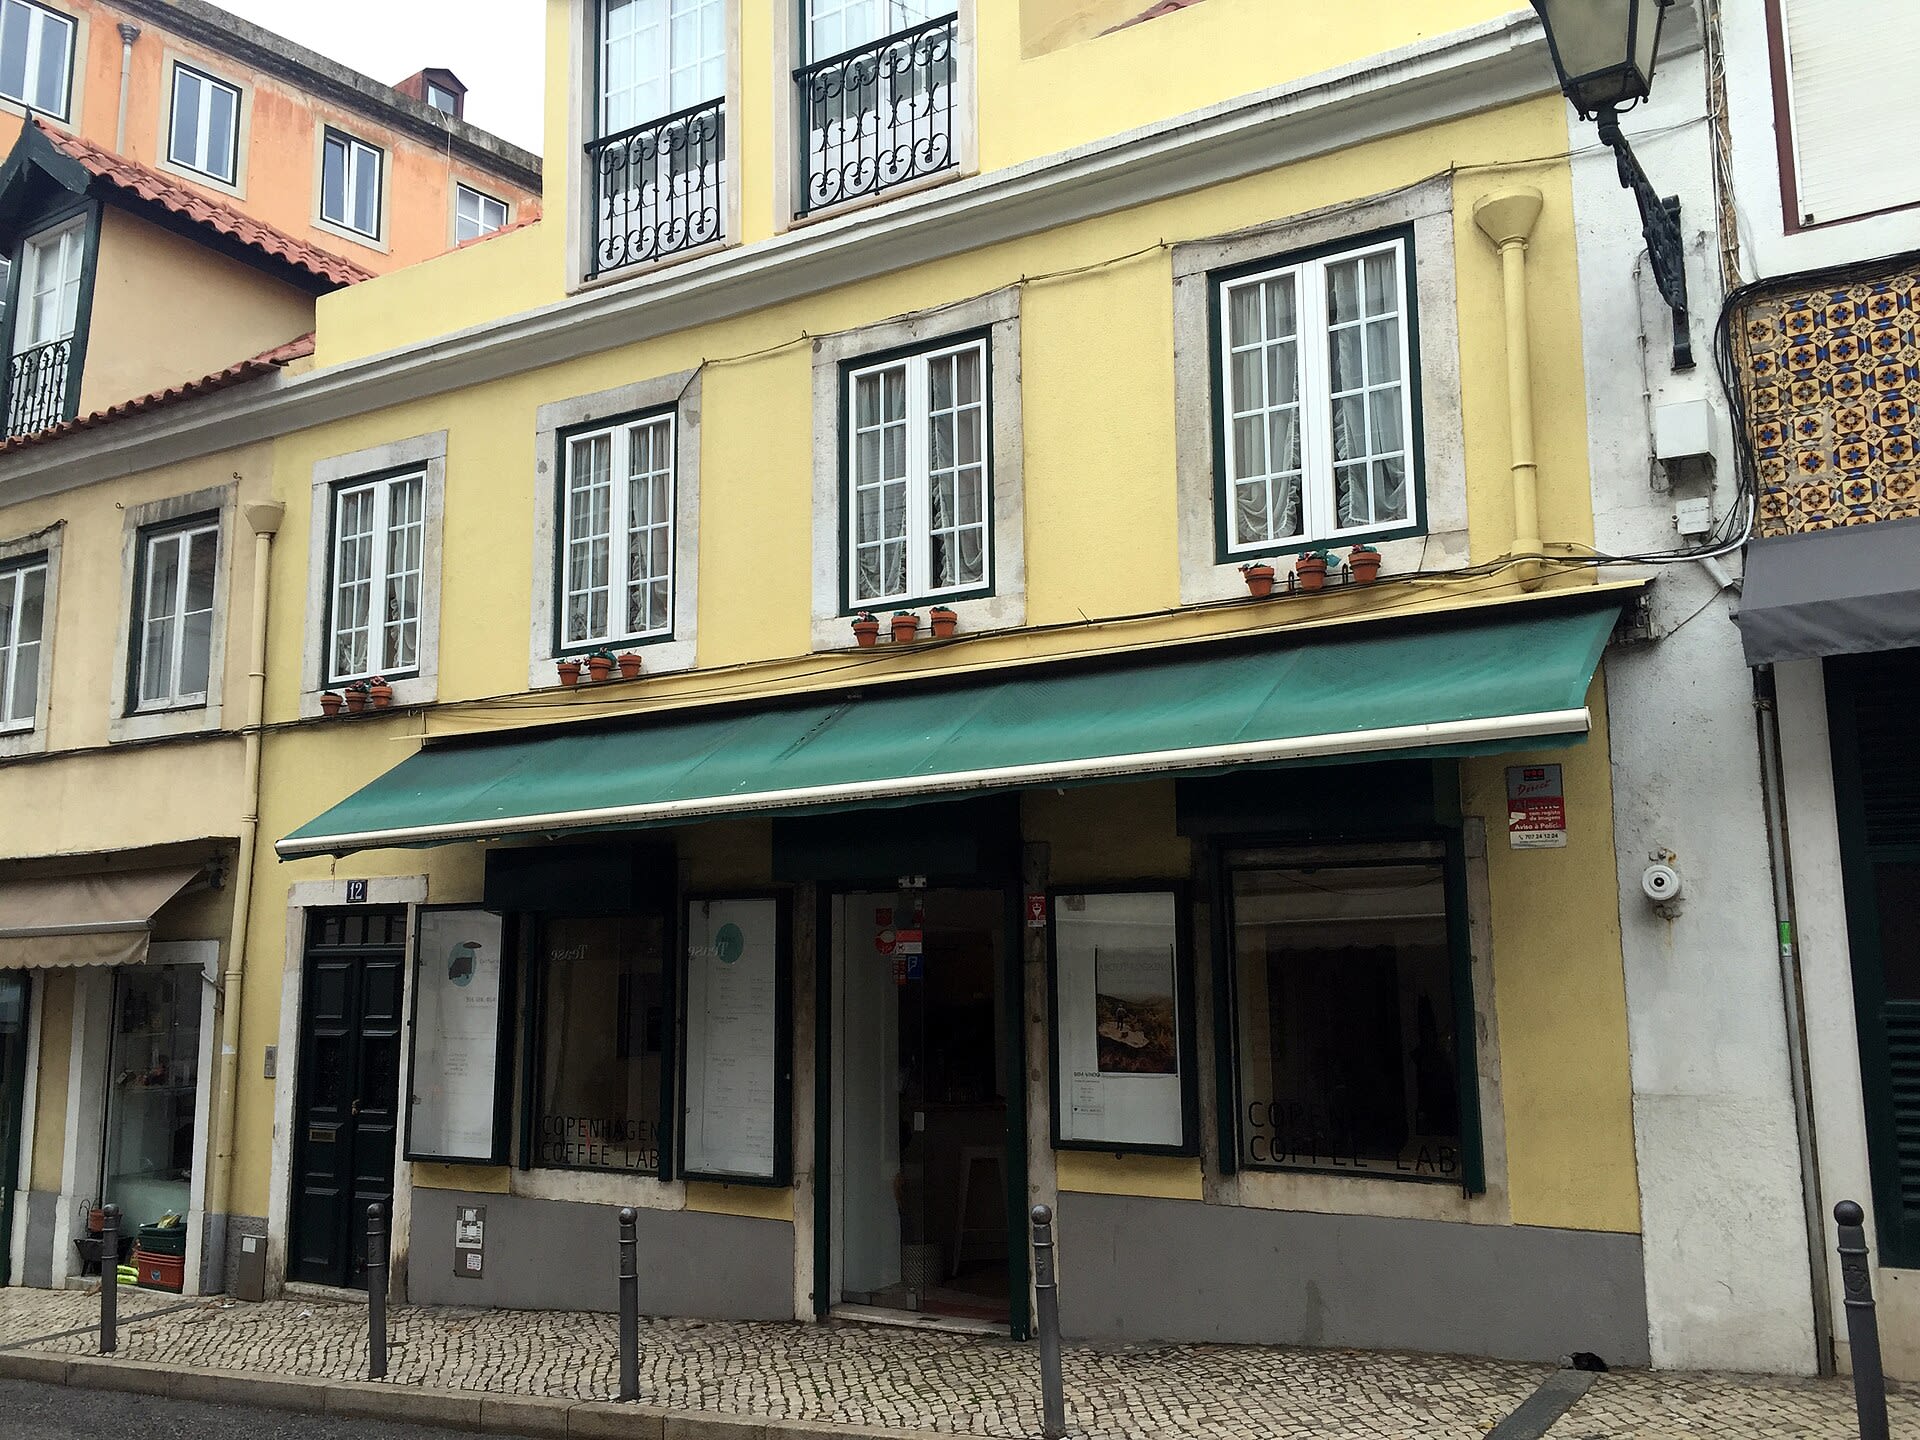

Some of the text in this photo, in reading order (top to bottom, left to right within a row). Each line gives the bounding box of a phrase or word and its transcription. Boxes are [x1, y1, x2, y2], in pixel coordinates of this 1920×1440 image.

[350, 882, 363, 900] 12
[542, 1115, 659, 1141] COPENHAGEN
[541, 1141, 660, 1168] COFFEE LAB
[1396, 1144, 1457, 1173] LAB
